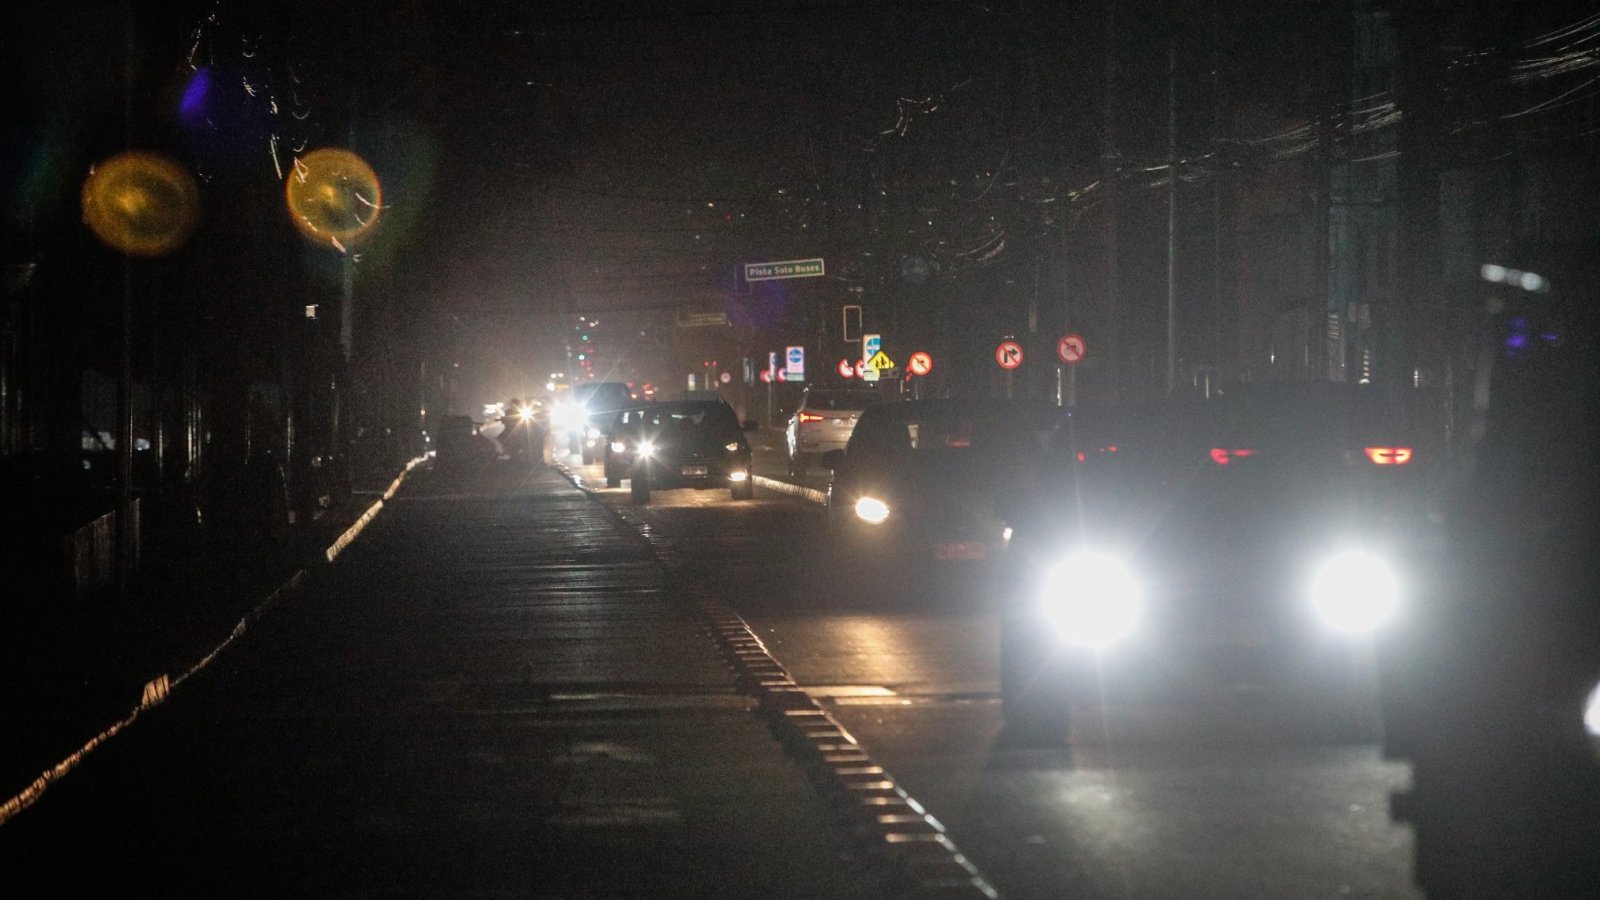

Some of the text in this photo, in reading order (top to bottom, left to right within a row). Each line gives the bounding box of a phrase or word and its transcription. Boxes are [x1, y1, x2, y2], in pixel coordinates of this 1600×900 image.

[749, 264, 820, 276] Pista Solo Buses
